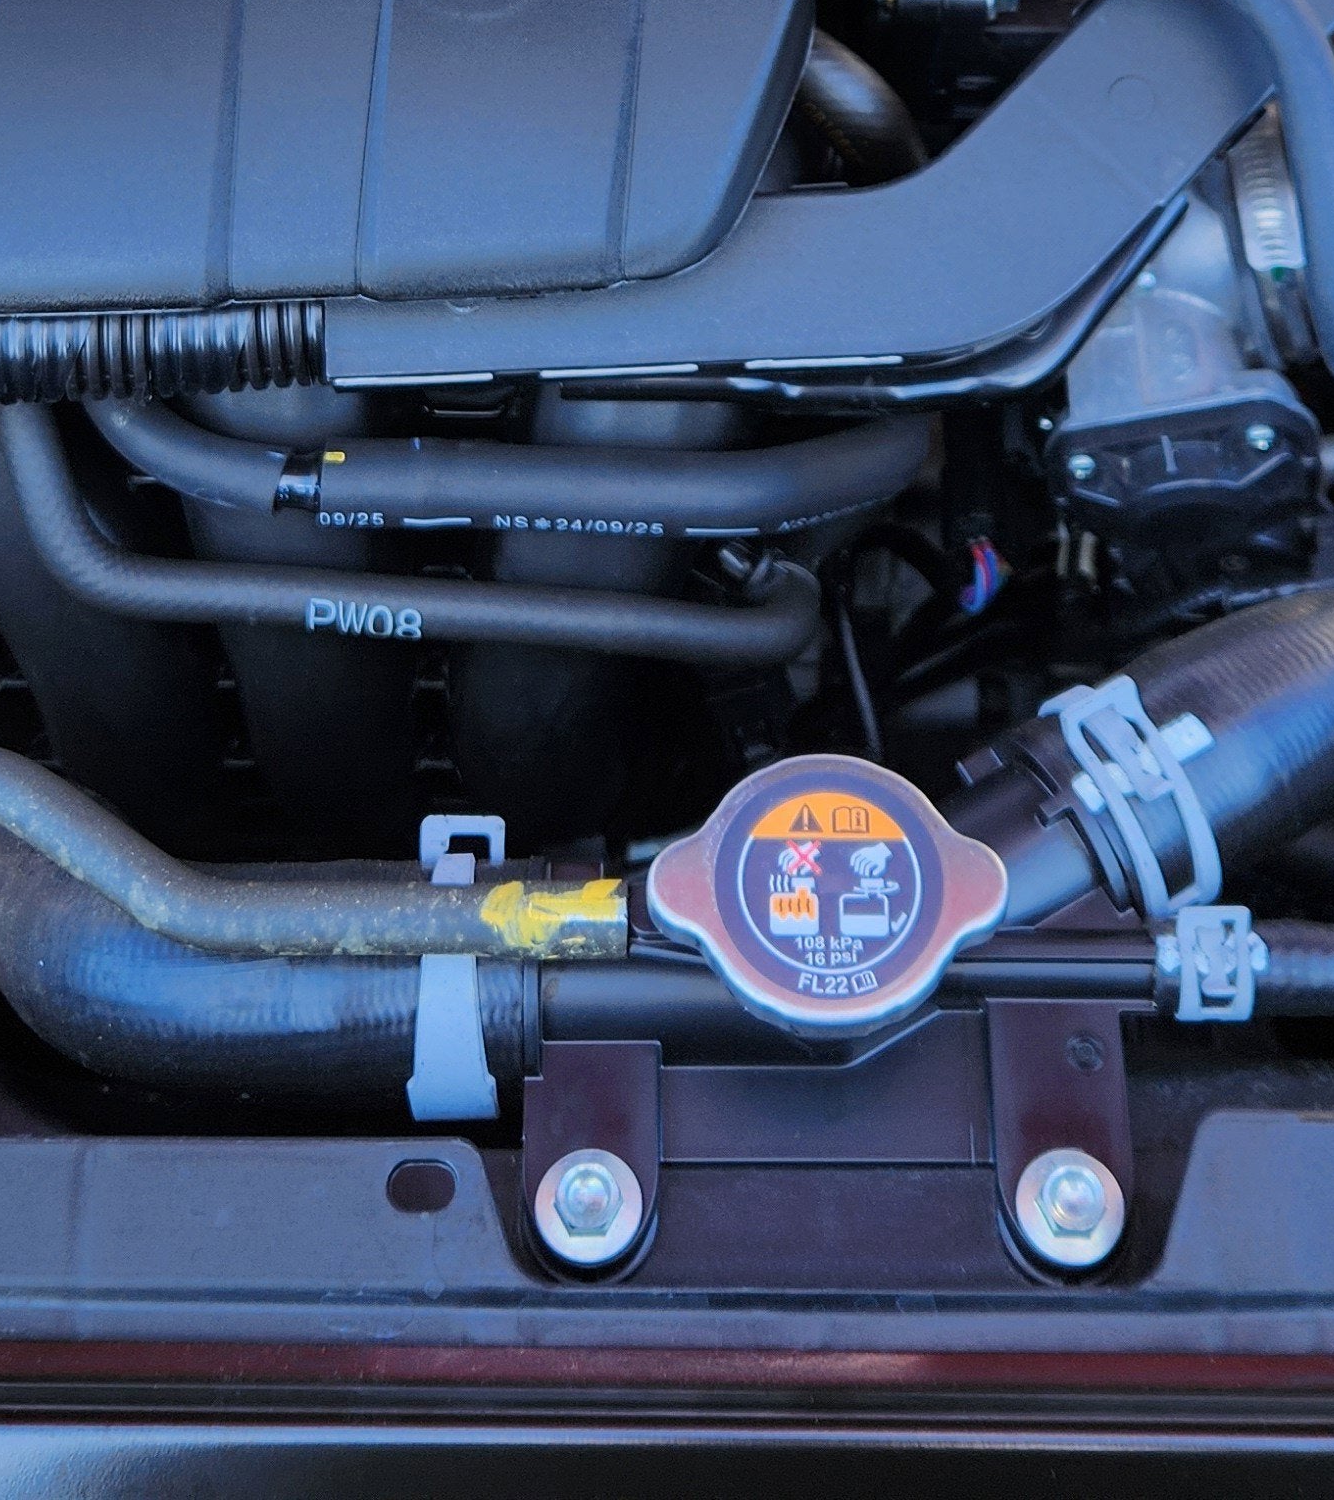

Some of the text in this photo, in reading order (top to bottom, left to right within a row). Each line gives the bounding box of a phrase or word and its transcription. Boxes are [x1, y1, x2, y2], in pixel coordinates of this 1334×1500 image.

[307, 597, 423, 638] PW08
[794, 935, 865, 952] 108 kPa
[805, 948, 859, 967] 16 psi
[797, 971, 850, 995] FL22
